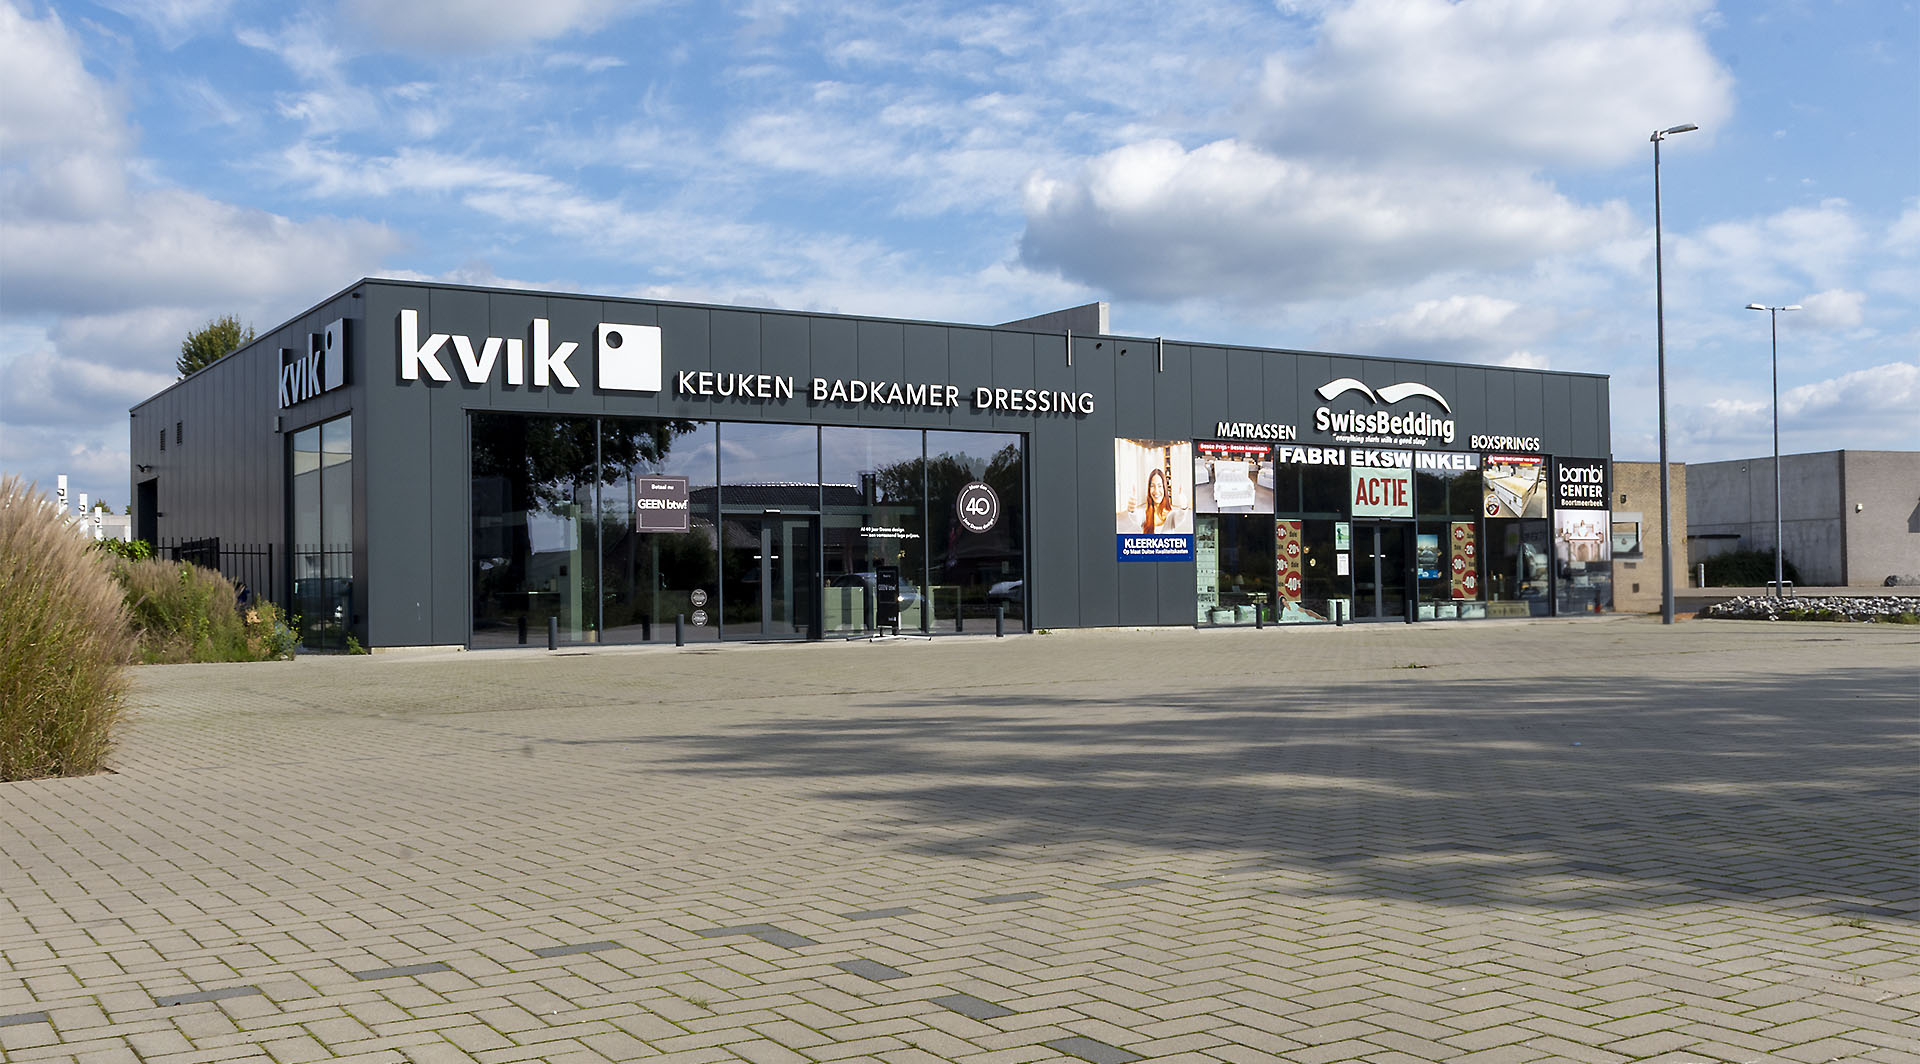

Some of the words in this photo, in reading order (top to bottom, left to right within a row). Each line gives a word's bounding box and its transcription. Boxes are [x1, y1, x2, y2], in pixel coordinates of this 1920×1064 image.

[400, 309, 581, 389] kvik
[278, 332, 321, 409] kvik
[678, 371, 794, 399] KEUKEN
[812, 378, 960, 407] BADKAMER
[976, 387, 1095, 414] DRESSING
[1217, 421, 1296, 440] MATRASSEN
[1316, 406, 1455, 443] SwissBedding
[1471, 434, 1541, 451] BOXSPRINGS
[1558, 463, 1603, 483] bambi
[1355, 477, 1408, 506] ACTIE
[1560, 484, 1603, 498] CENTER
[637, 498, 666, 510] GEEN
[965, 497, 990, 516] 40
[1561, 498, 1604, 507] Boortmeerbeek
[1124, 538, 1187, 549] KLEERKASTEN
[1464, 545, 1474, 555] -20
